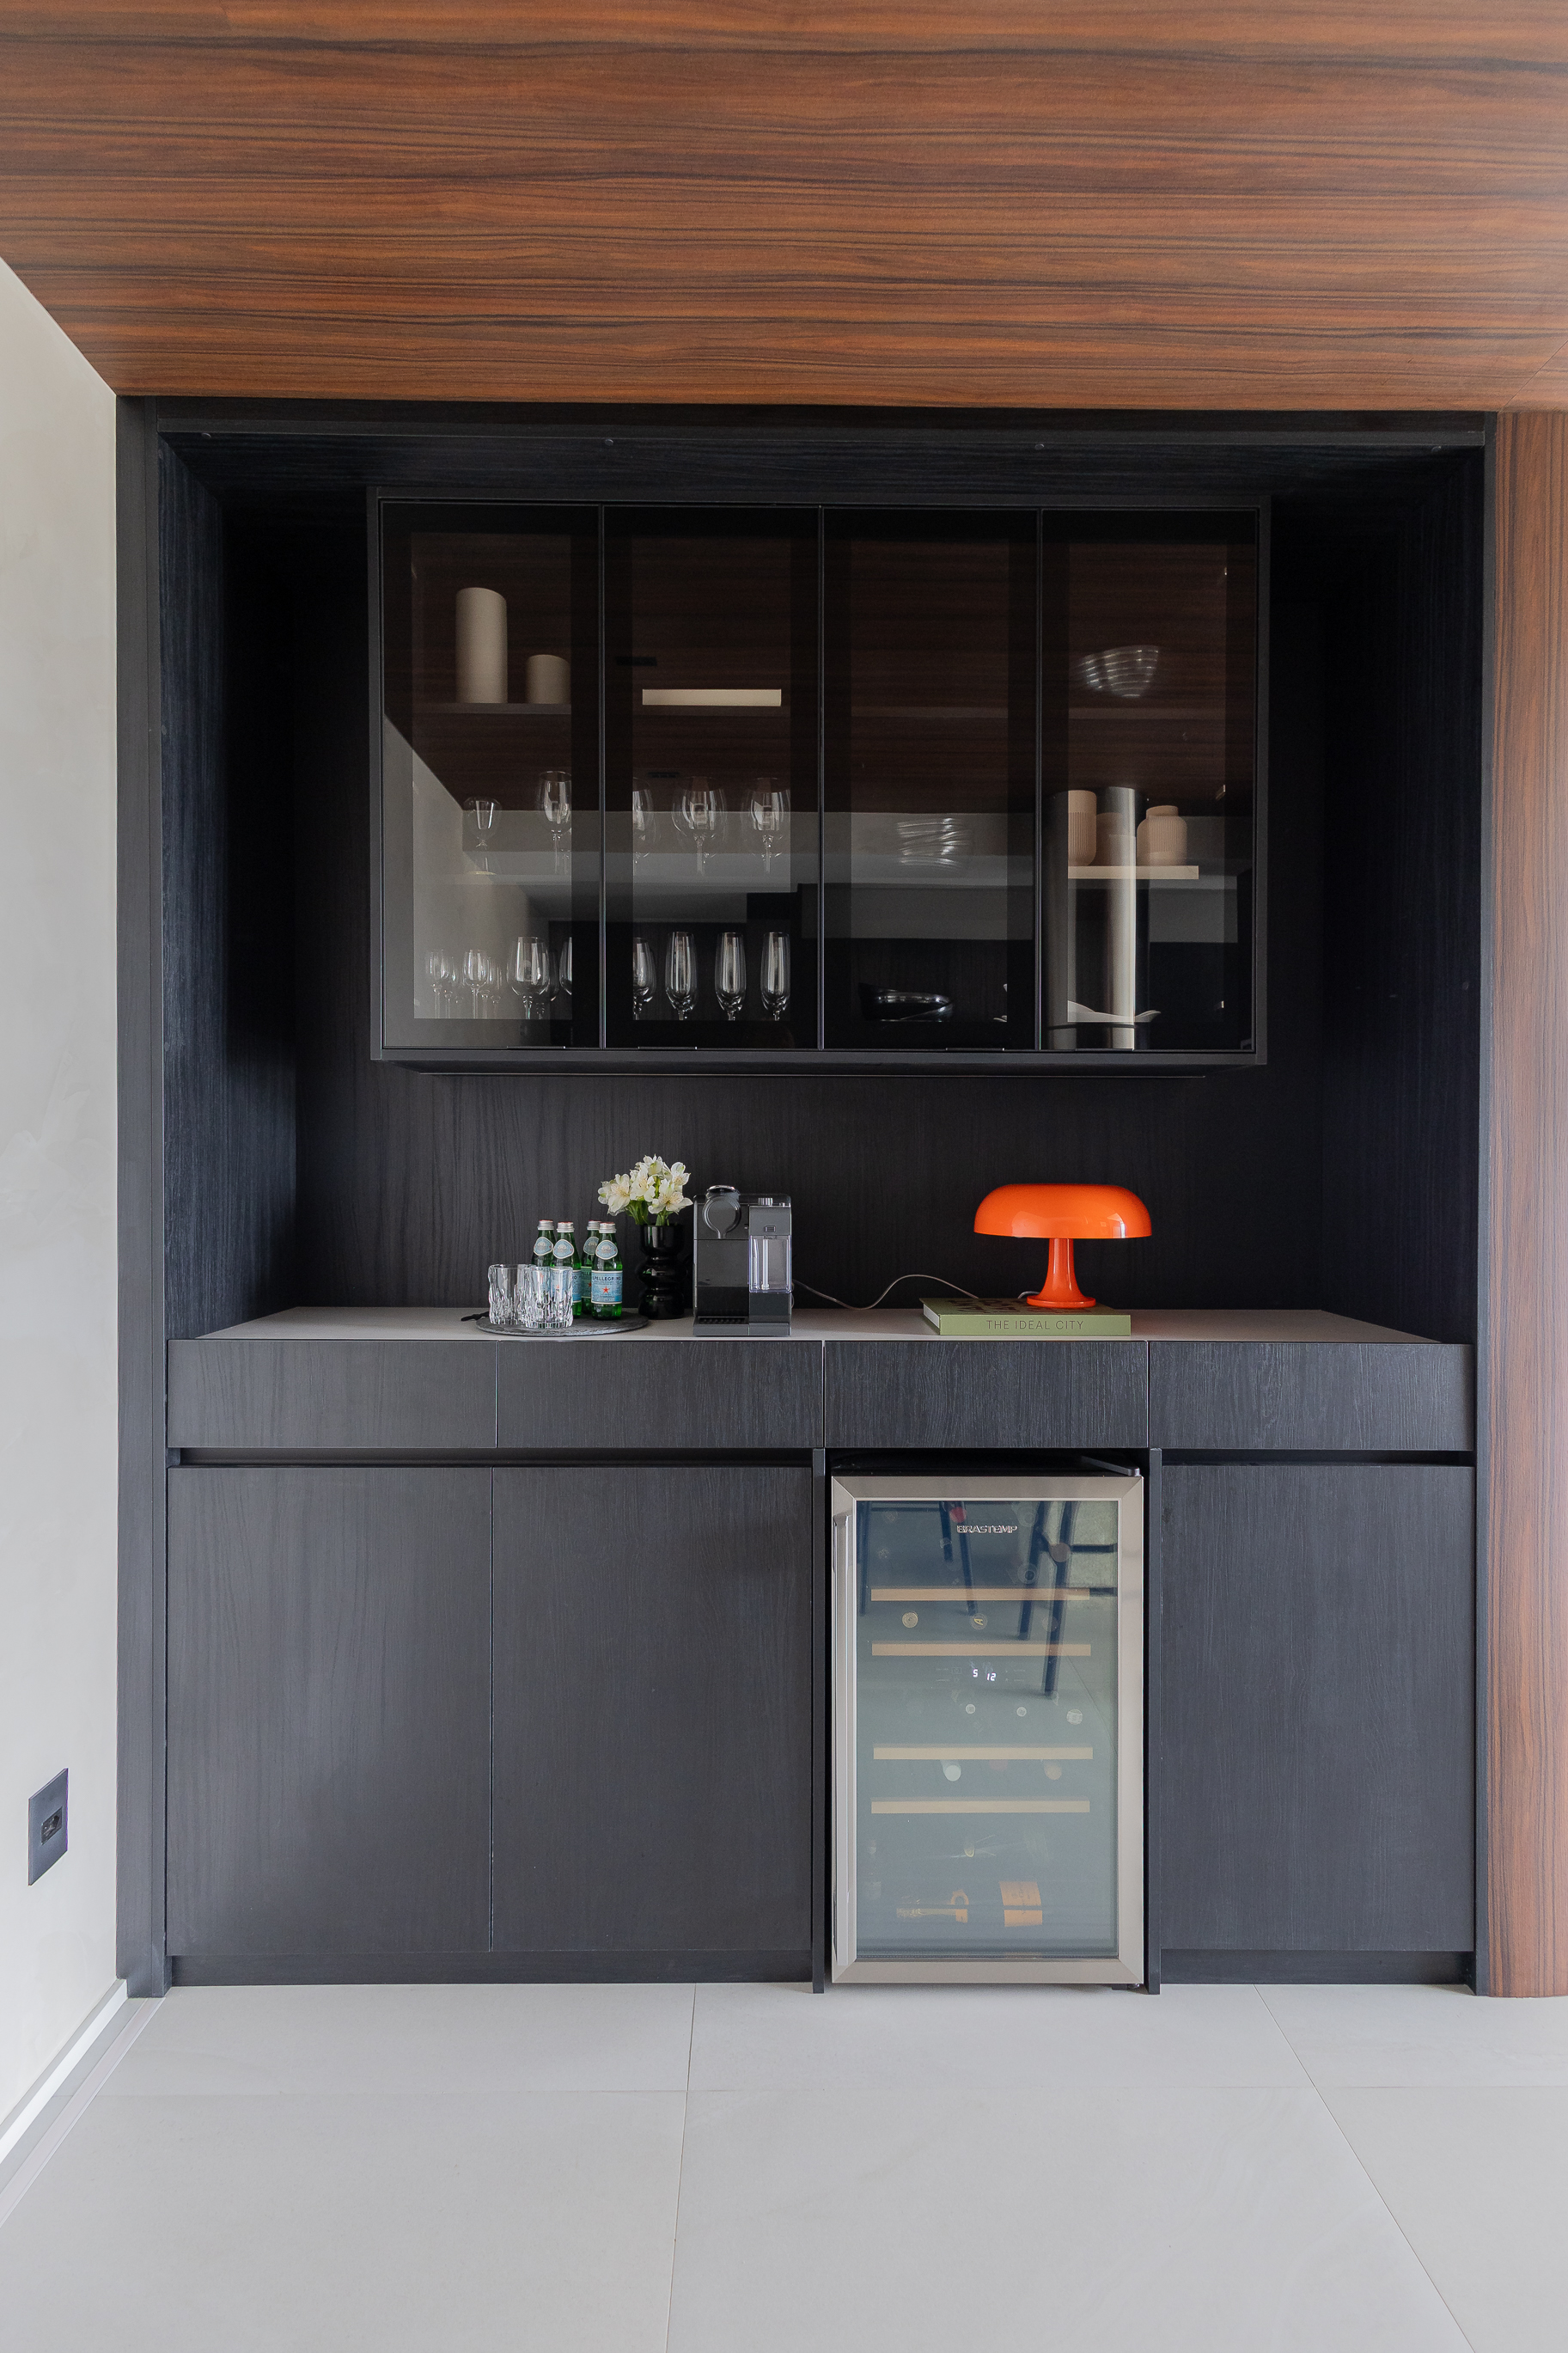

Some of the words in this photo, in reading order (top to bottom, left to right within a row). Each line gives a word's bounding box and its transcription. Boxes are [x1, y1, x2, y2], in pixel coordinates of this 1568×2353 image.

[986, 1320, 1010, 1329] THE
[1015, 1320, 1050, 1329] IDEAL
[1055, 1320, 1083, 1329] CITY
[956, 1525, 1018, 1534] BRASTEMP
